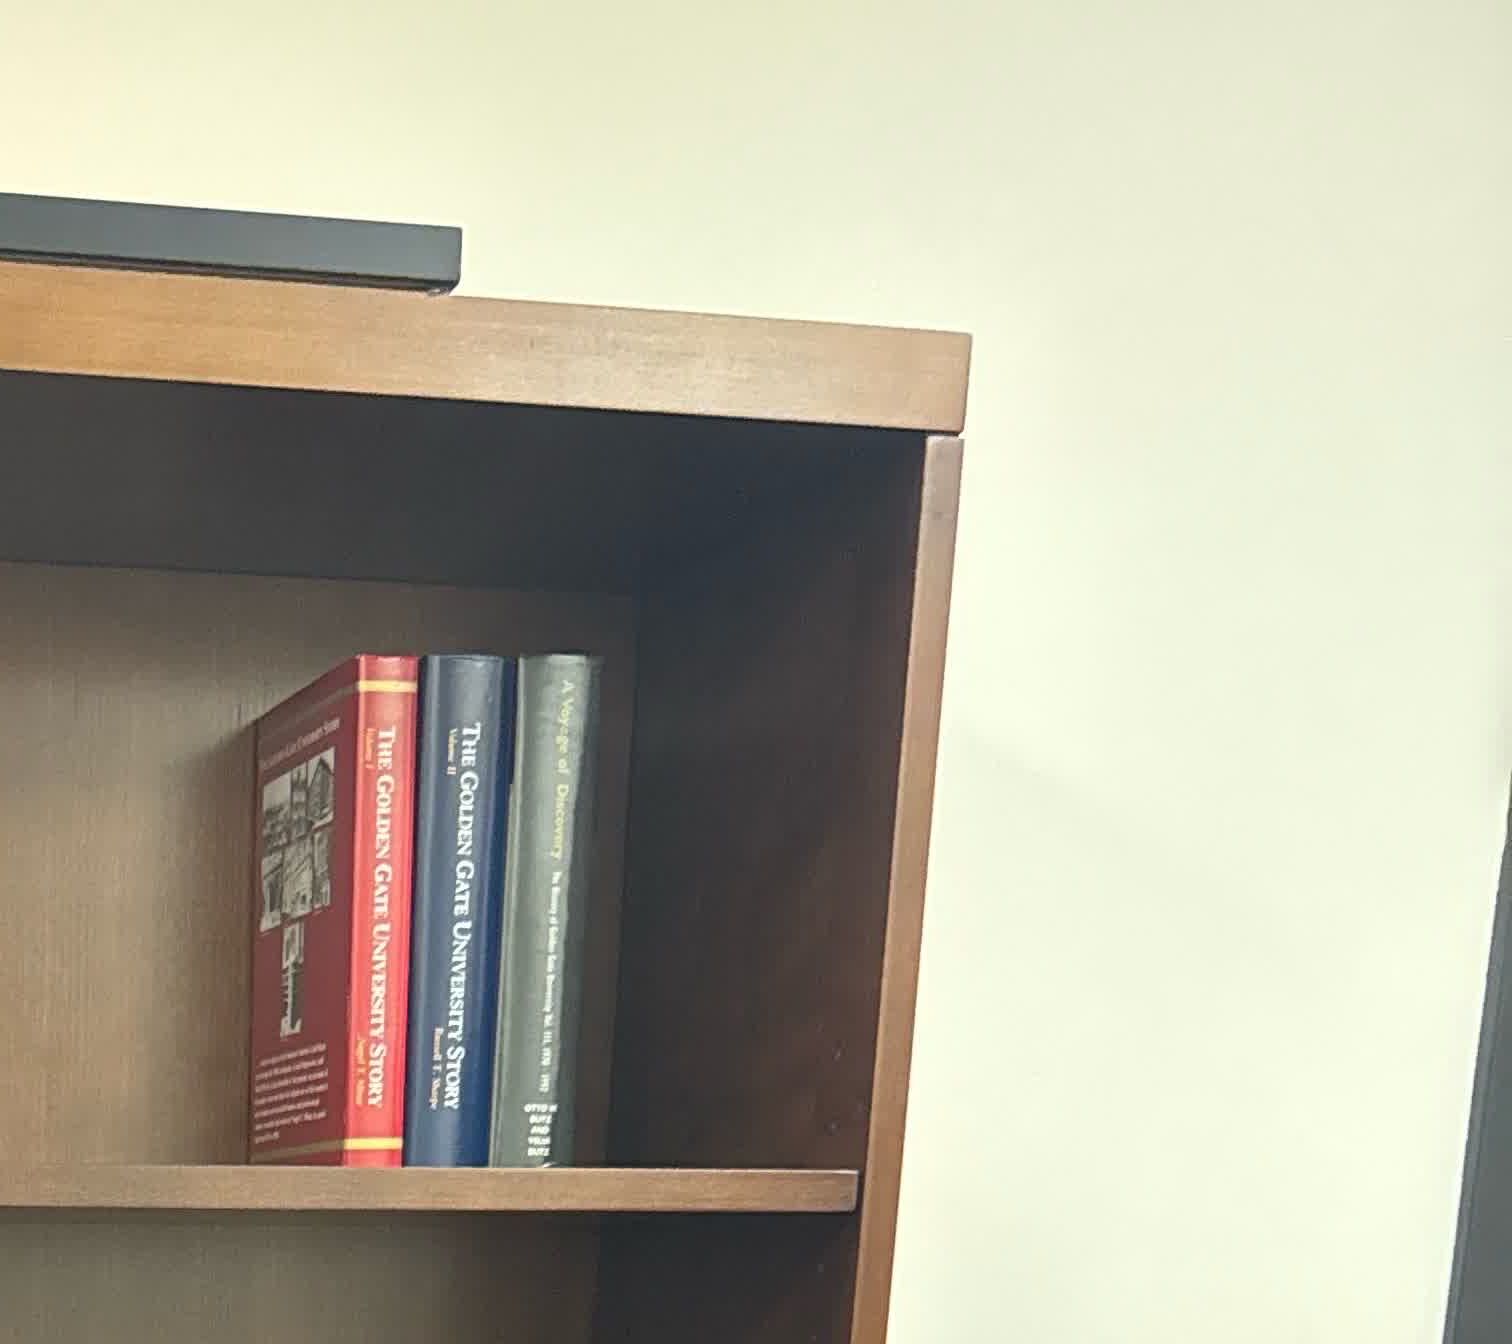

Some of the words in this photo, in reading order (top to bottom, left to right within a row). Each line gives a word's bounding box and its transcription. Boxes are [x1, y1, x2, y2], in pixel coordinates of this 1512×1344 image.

[376, 725, 396, 770] THE
[460, 722, 481, 767] THE
[375, 774, 395, 859] GOLDEN
[457, 771, 479, 857] GOLDEN
[373, 863, 393, 919] GATE
[453, 860, 475, 917] GATE
[369, 923, 391, 1041] UNIVERSITY
[447, 920, 472, 1042] UNIVERSITY
[367, 1042, 388, 1109] STORY
[443, 1045, 466, 1111] STORY
